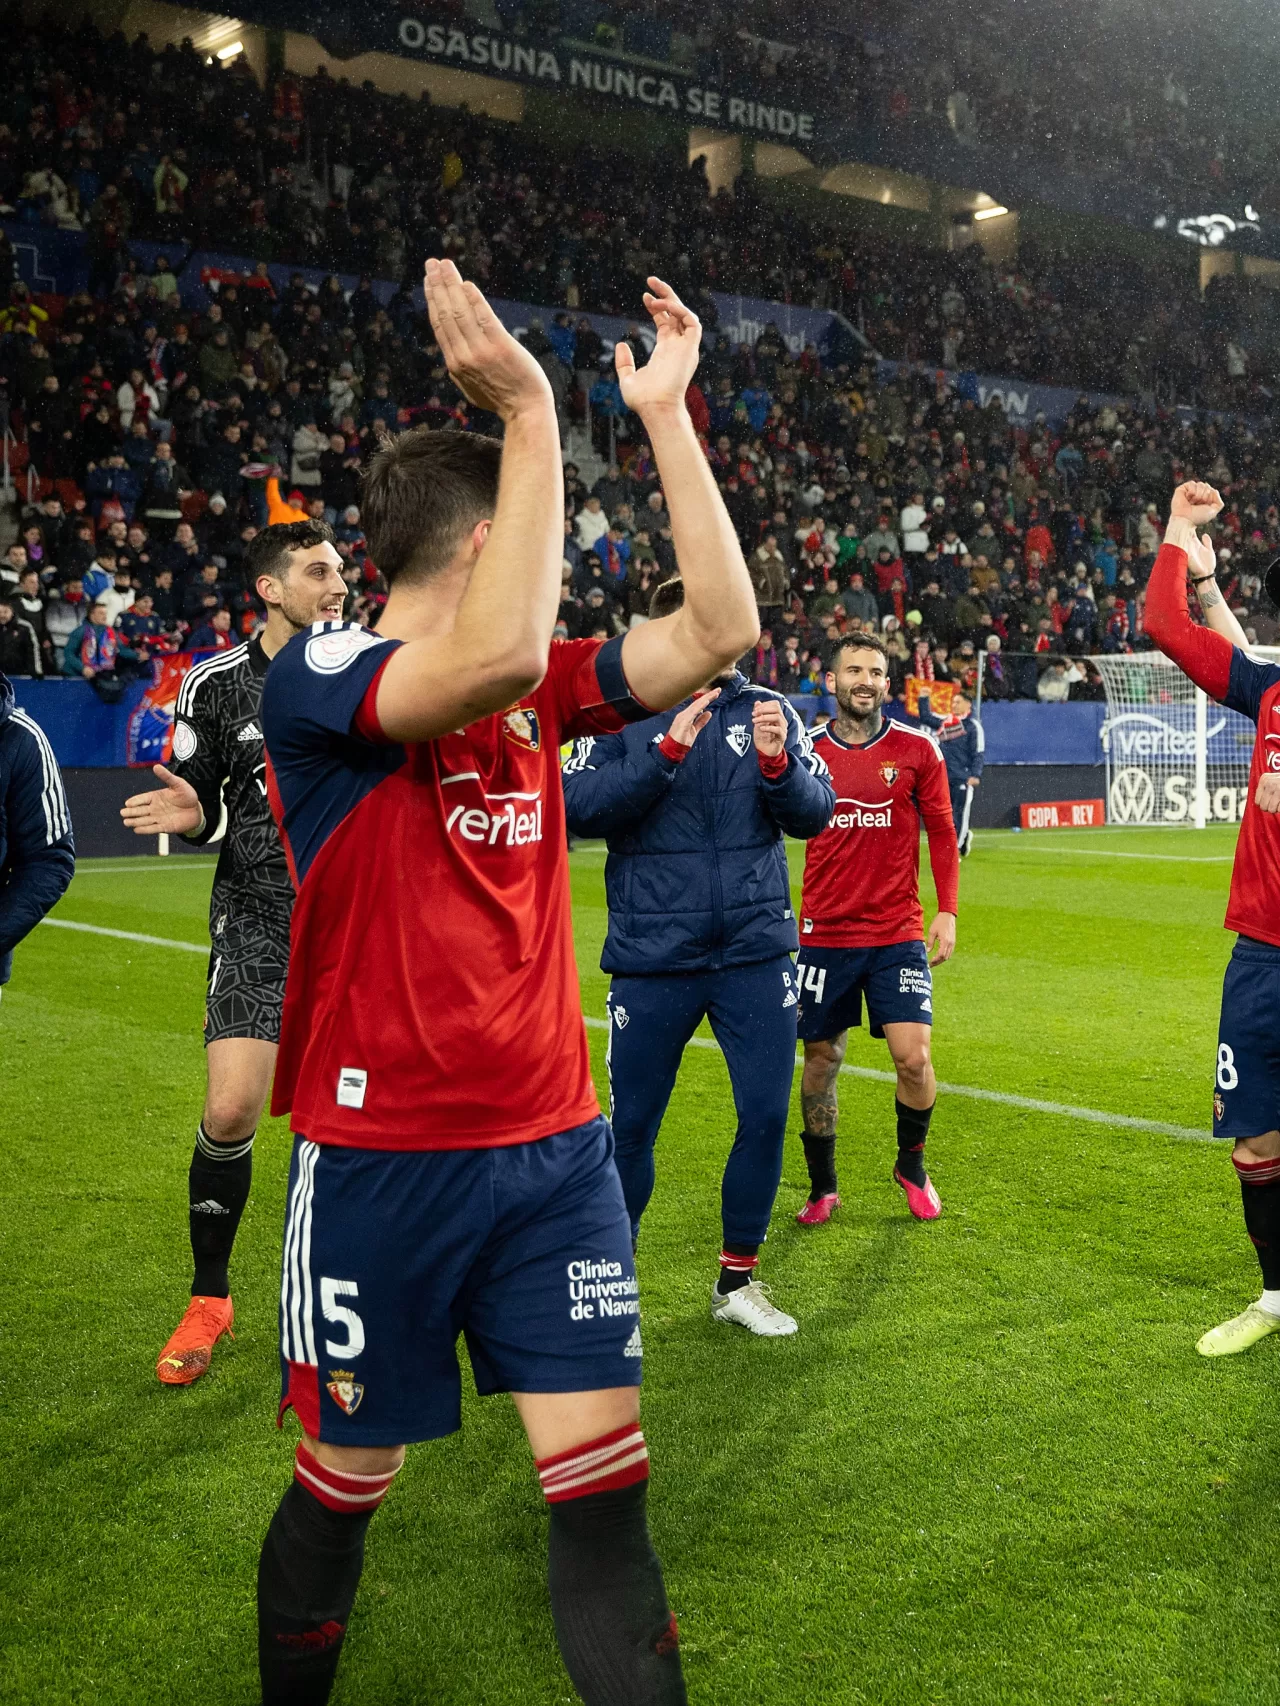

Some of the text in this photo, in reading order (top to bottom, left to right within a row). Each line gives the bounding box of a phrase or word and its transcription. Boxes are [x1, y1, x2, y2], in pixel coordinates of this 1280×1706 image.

[399, 18, 814, 140] OSASUNA NUNCA SE RINDE
[1119, 723, 1208, 755] verlea
[1028, 804, 1094, 829] COPA REY
[794, 963, 827, 1004] 14
[1217, 1043, 1239, 1090] 8
[567, 1259, 623, 1281] Clínica
[320, 1276, 366, 1360] 5
[570, 1300, 595, 1321] de
